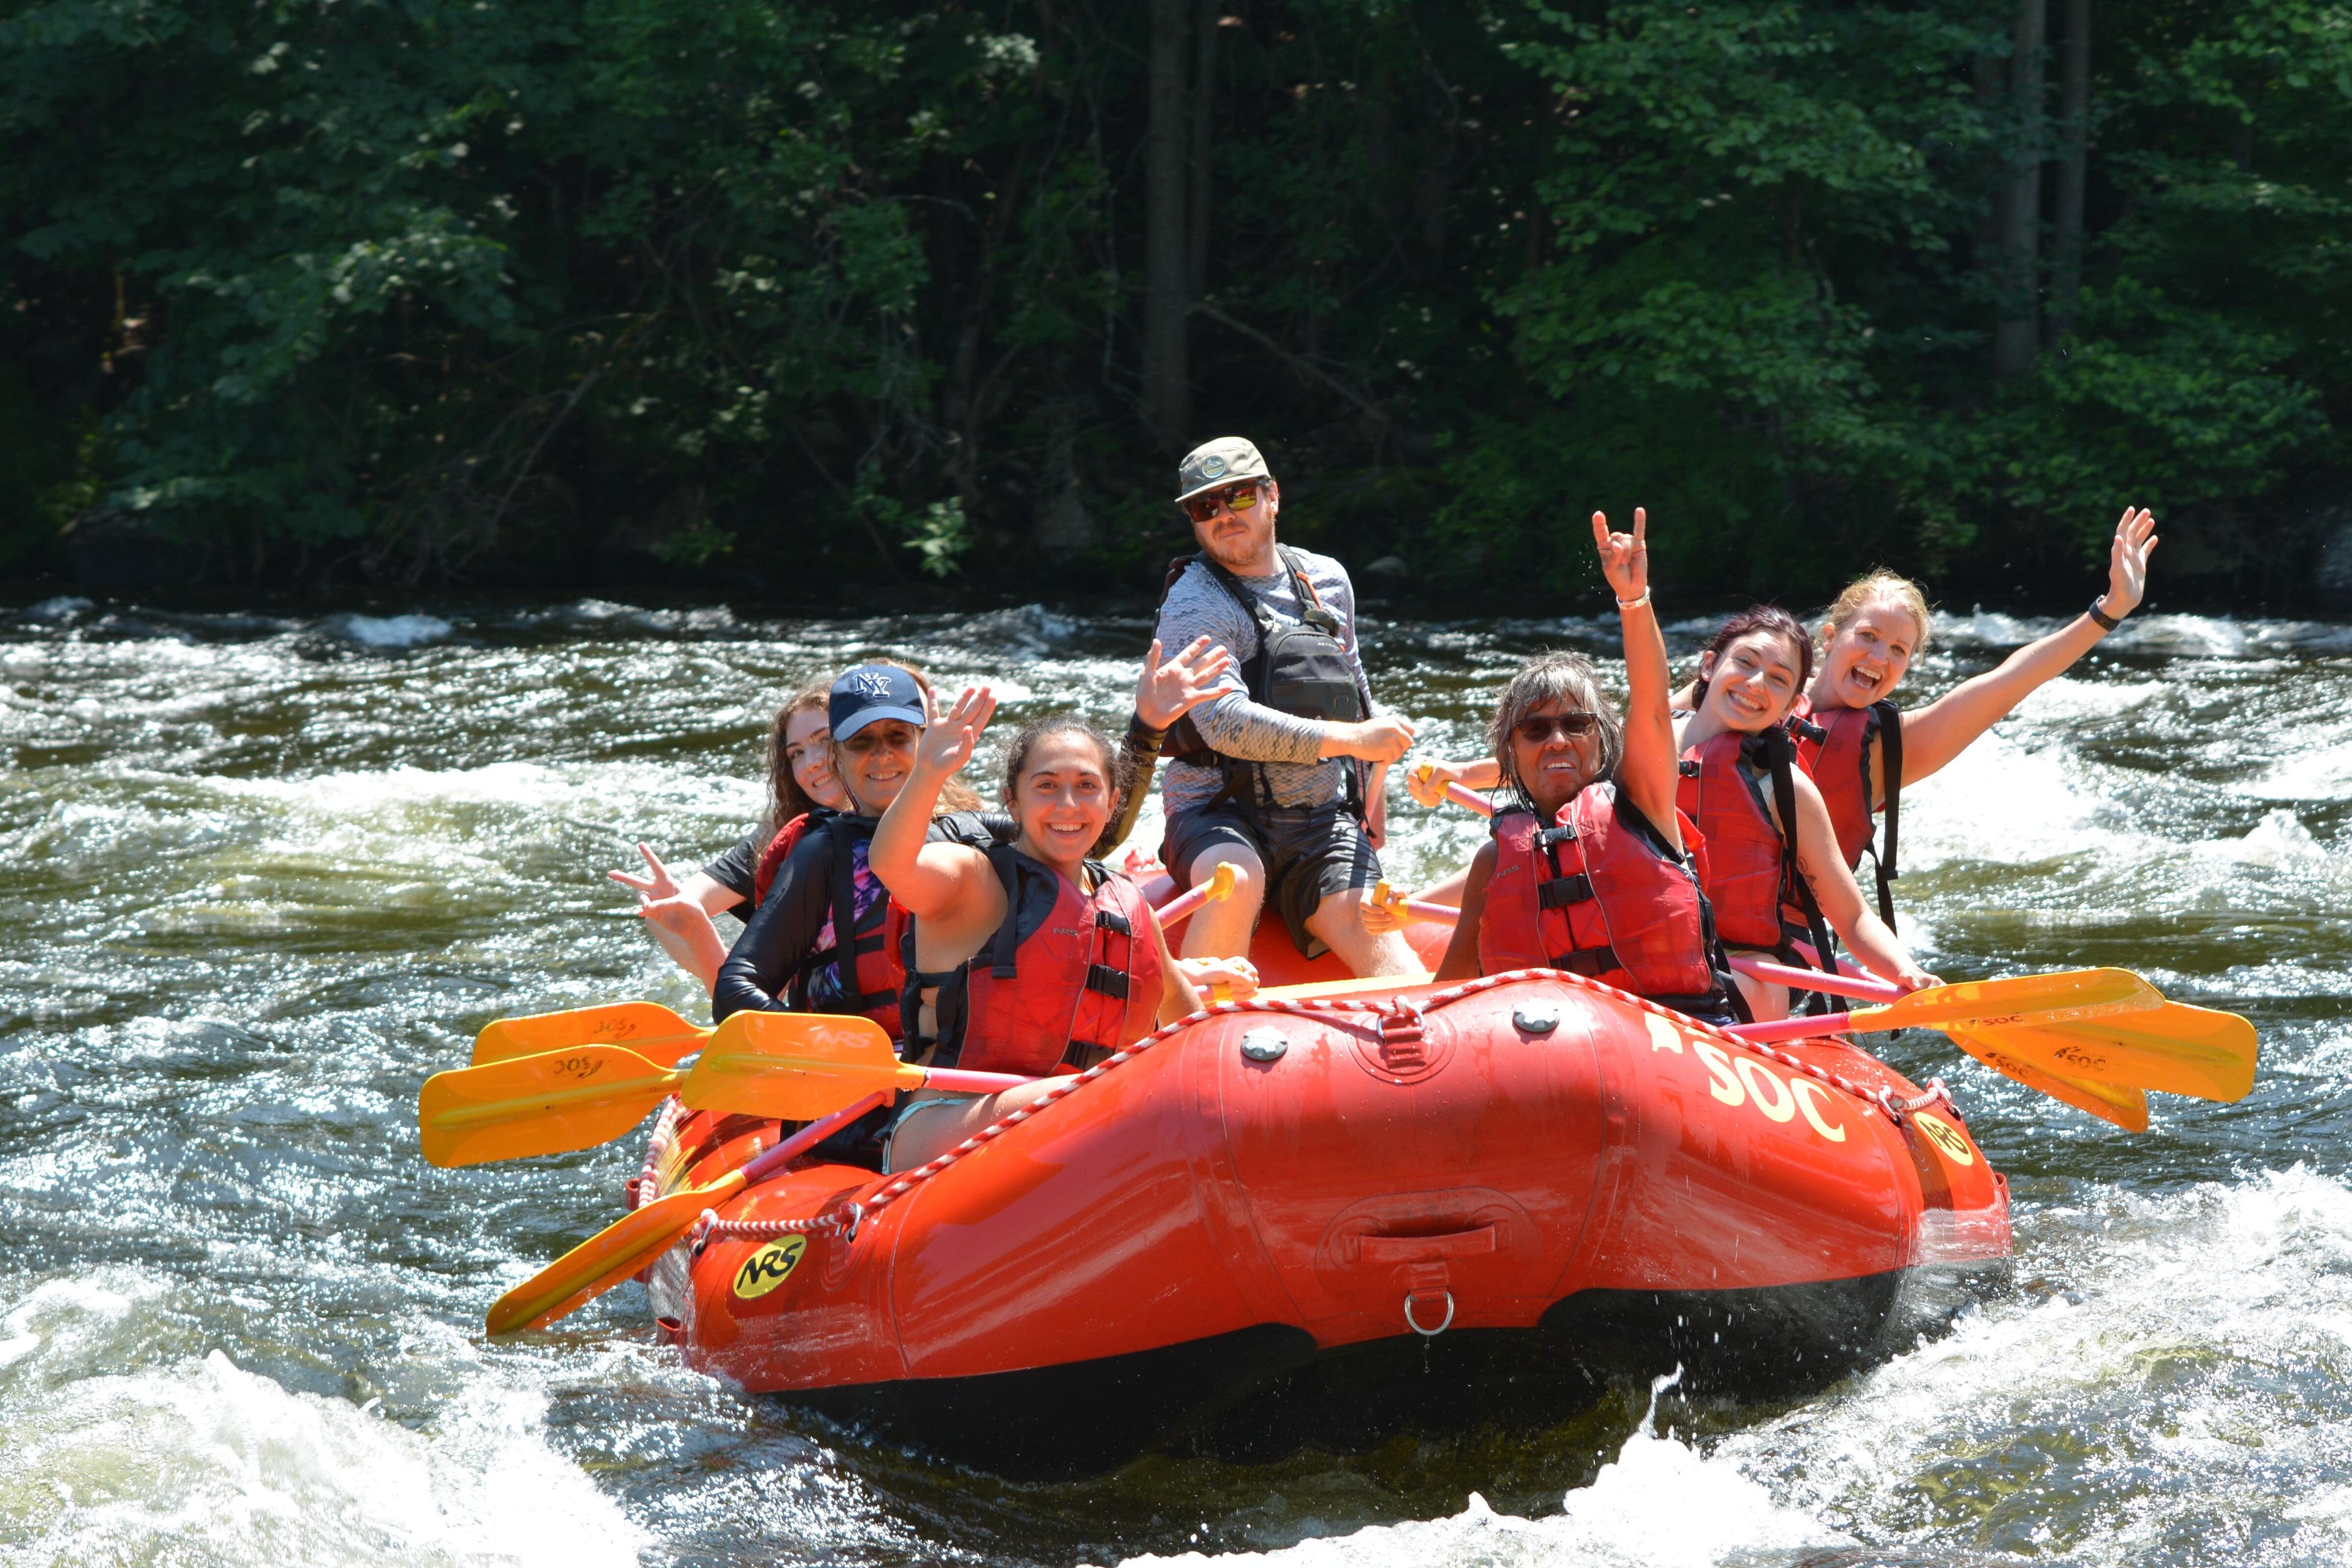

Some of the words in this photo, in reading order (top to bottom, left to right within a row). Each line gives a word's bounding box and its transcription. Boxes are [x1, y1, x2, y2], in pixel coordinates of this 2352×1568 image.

[852, 672, 892, 698] NY
[1497, 864, 1520, 879] NRS
[1053, 927, 1079, 937] NRS
[1983, 1014, 2024, 1027] SOC
[813, 1029, 874, 1049] NRS
[1995, 1058, 2030, 1079] SOC
[2067, 1053, 2106, 1071] SOC
[1693, 1041, 1846, 1142] SOC
[1918, 1120, 1969, 1155] NRS
[736, 1242, 803, 1290] NRS
